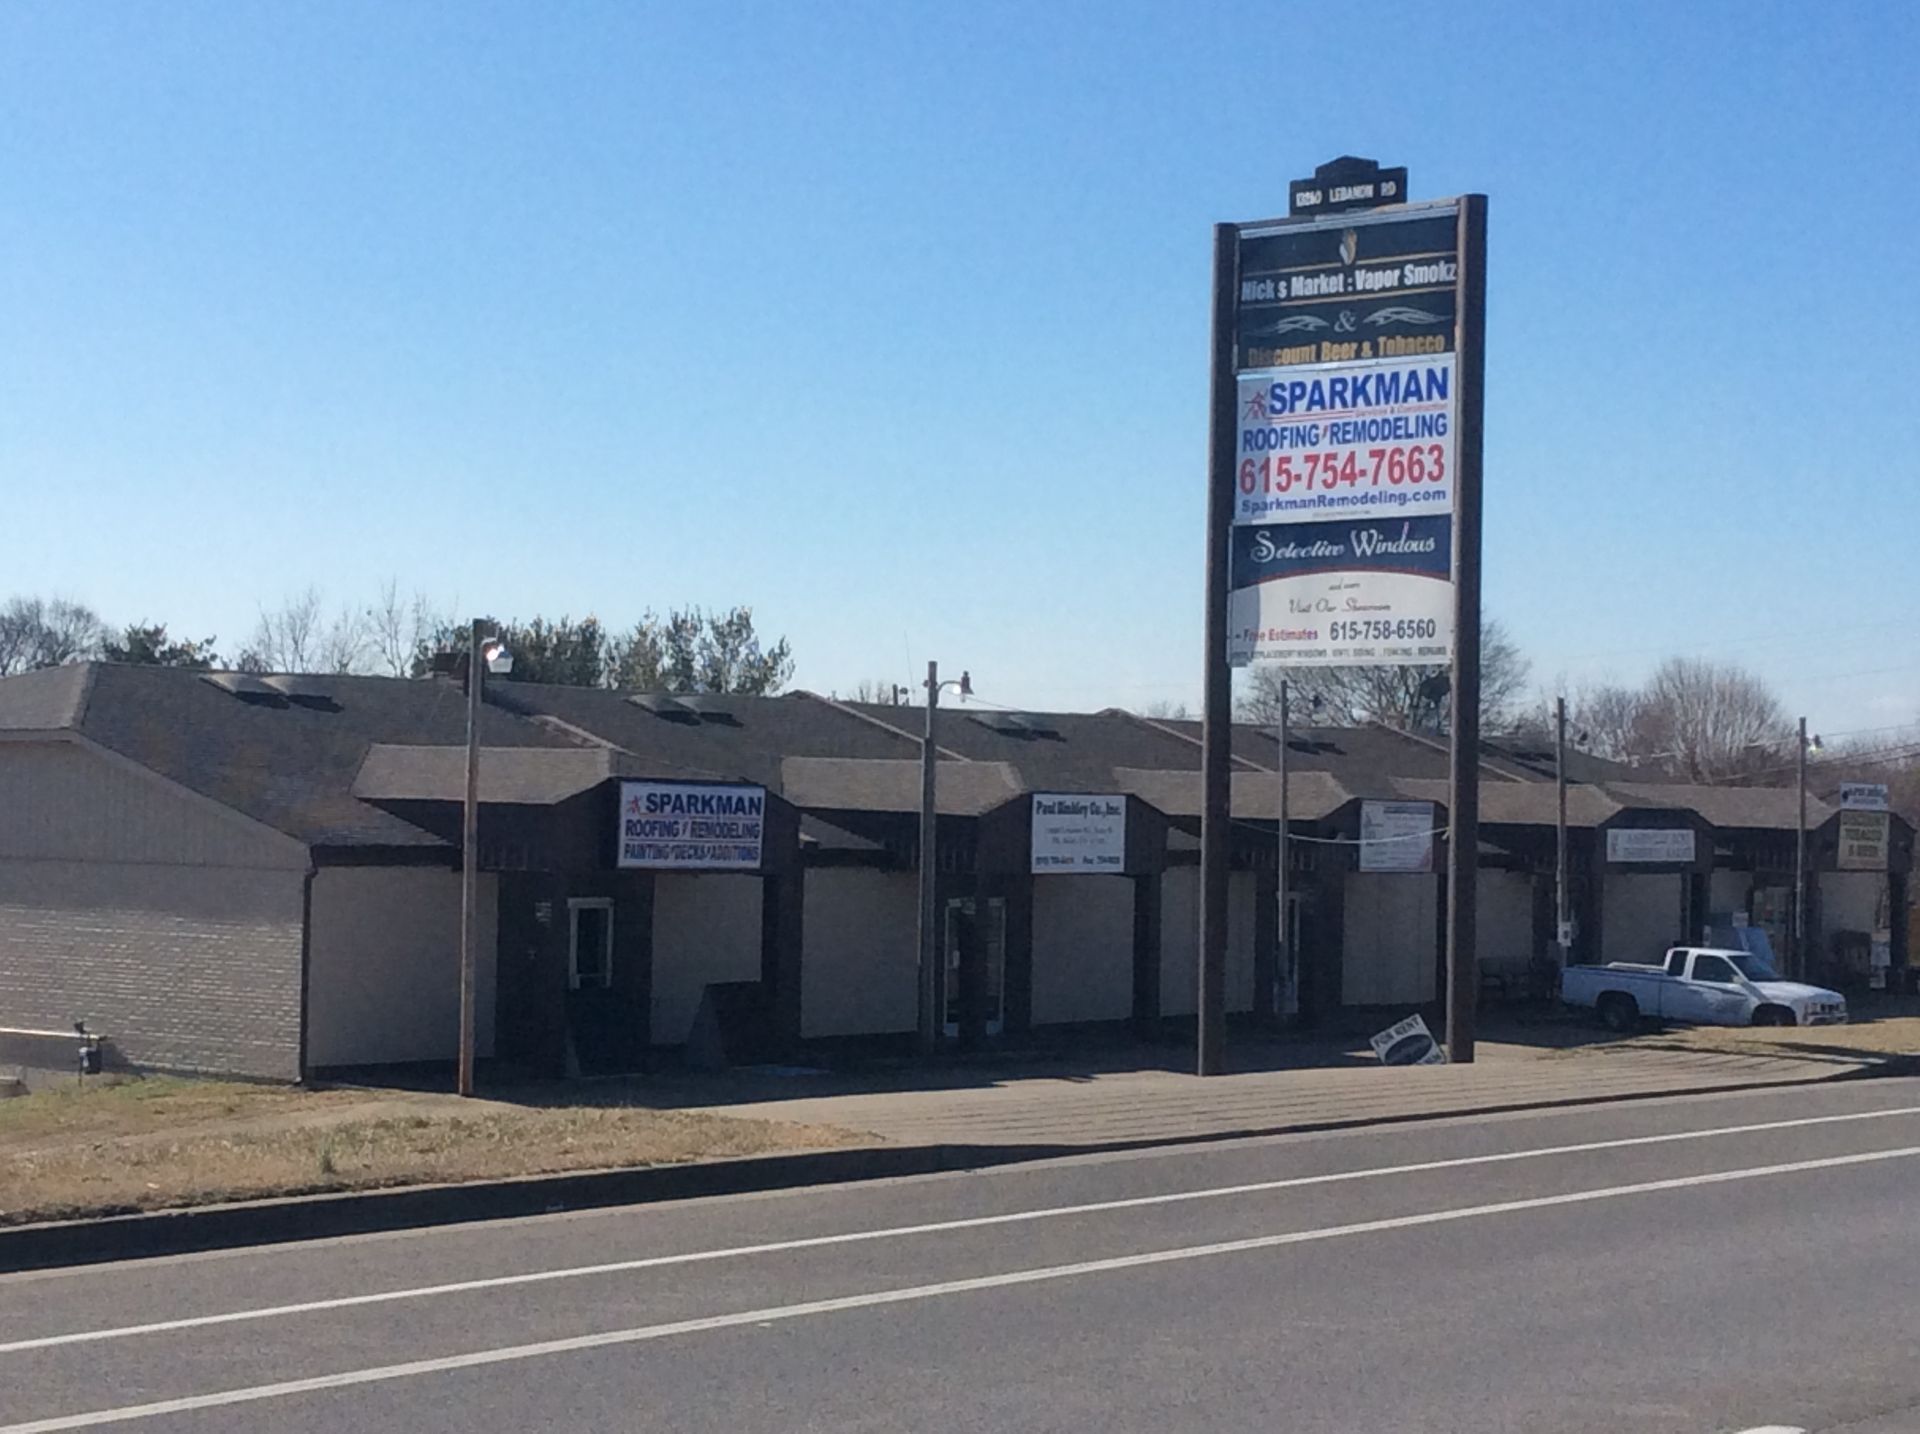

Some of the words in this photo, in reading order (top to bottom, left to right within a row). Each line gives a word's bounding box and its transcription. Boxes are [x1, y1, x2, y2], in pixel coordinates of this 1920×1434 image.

[1329, 185, 1374, 202] LEBANON
[1381, 181, 1397, 197] RD
[1291, 273, 1345, 297] Market
[1355, 267, 1401, 292] Vapor
[1334, 309, 1358, 333] &
[1321, 338, 1359, 362] Beer
[1361, 340, 1373, 359] &
[1378, 334, 1446, 356] Tobacco
[1269, 367, 1449, 416] SPARKMAN
[1239, 443, 1446, 496] 615-754-7663
[1241, 489, 1447, 515] SparkmanRemodeling.com
[1251, 530, 1345, 563] Selective
[1350, 522, 1436, 558] Windows
[1316, 598, 1337, 613] Our
[1267, 627, 1319, 641] Estimates
[1329, 618, 1436, 641] 615-758-6560
[645, 792, 762, 816] SPARKMAN
